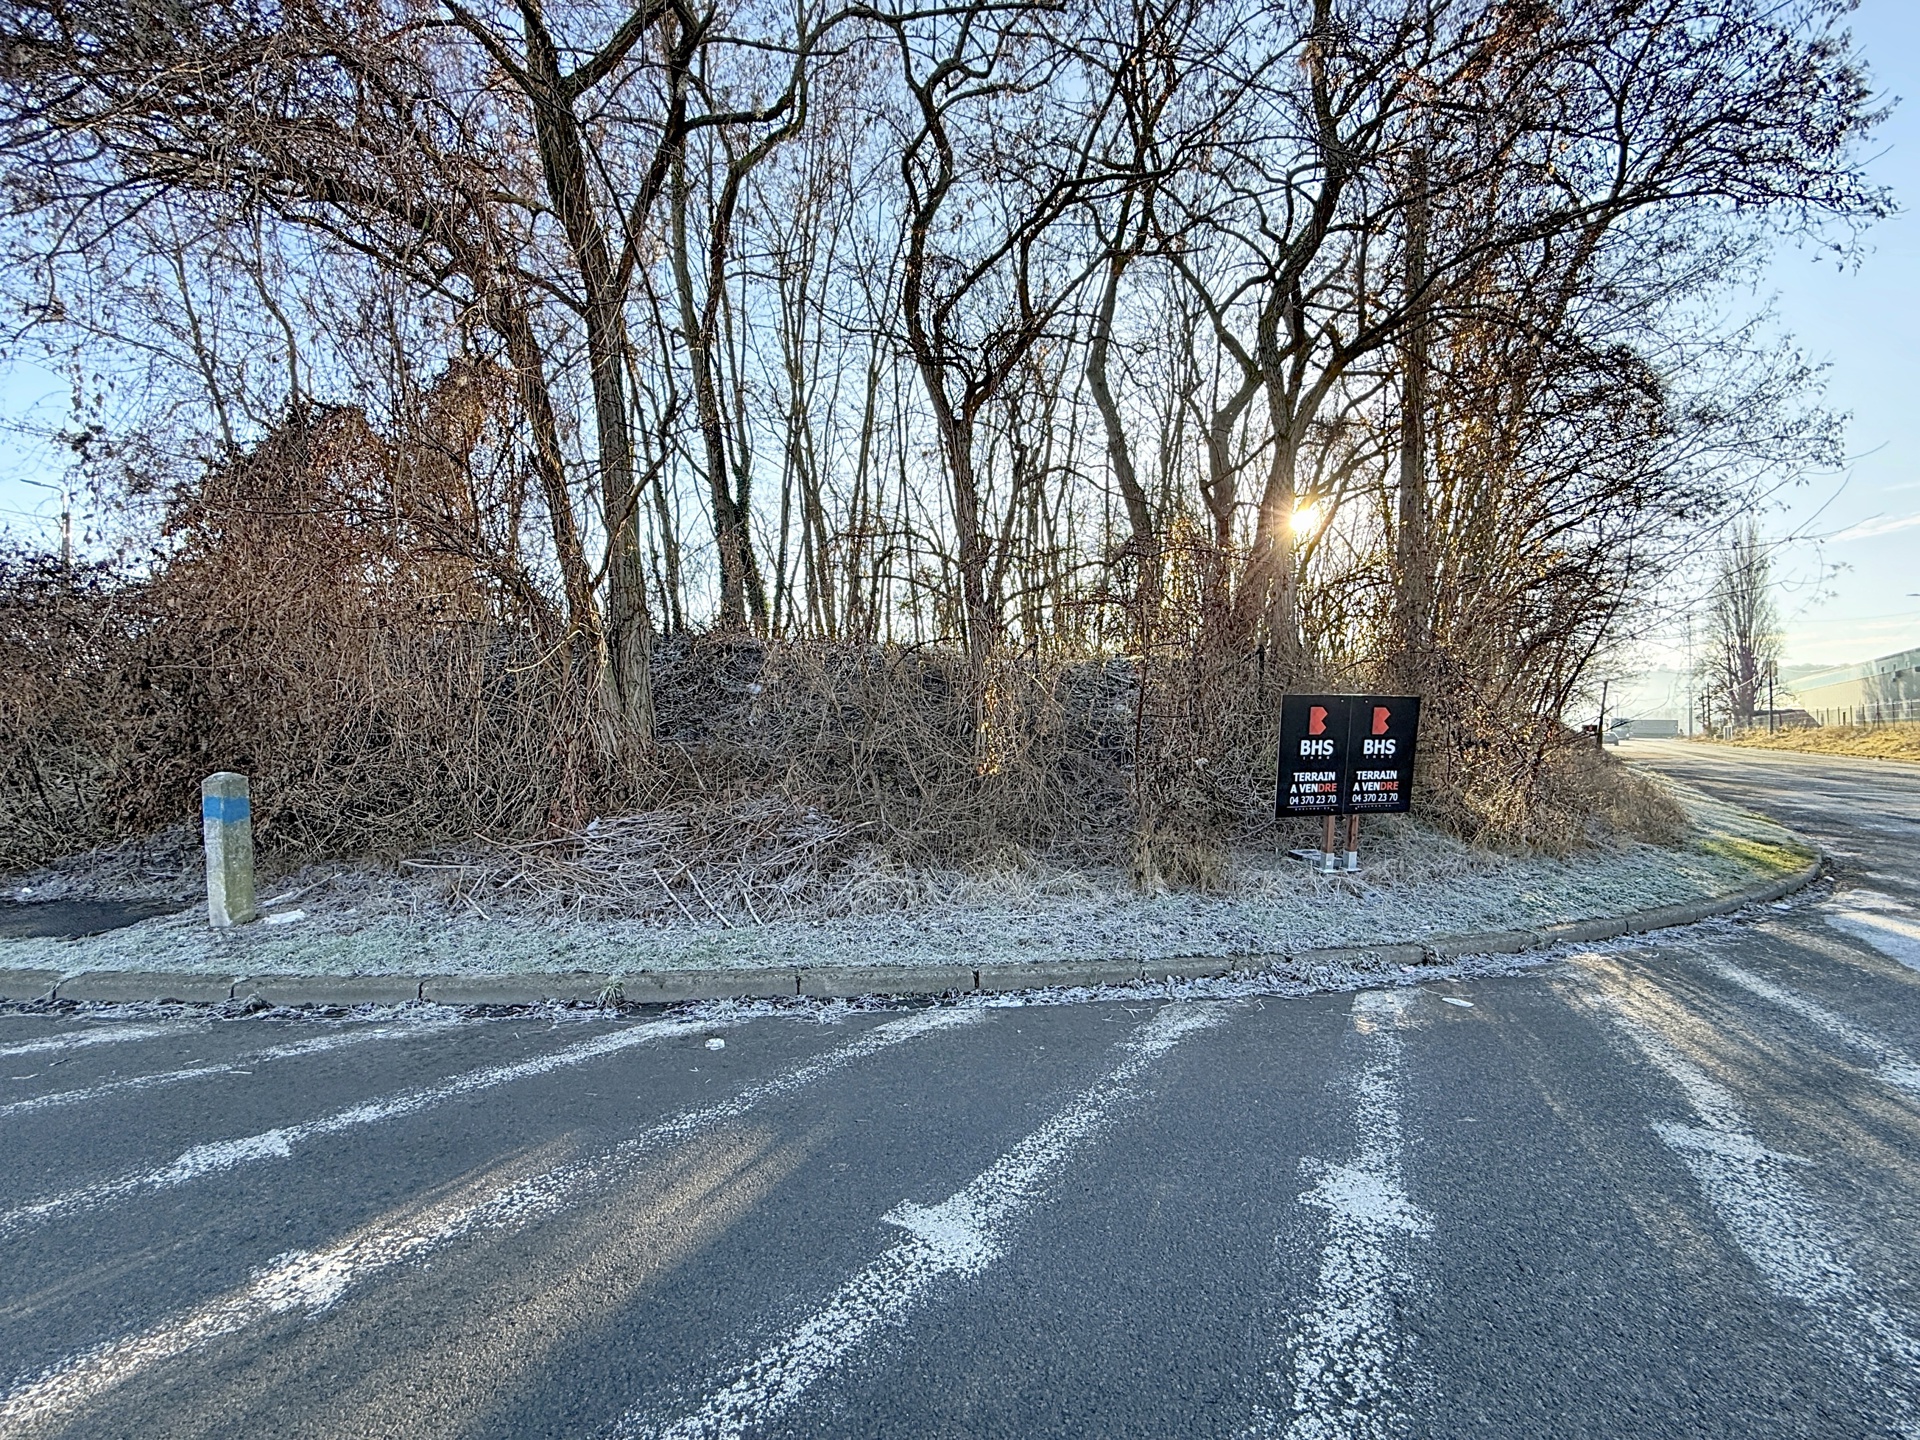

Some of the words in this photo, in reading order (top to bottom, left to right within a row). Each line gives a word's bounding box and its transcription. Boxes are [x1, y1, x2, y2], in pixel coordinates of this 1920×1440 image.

[1300, 740, 1334, 755] BHS
[1364, 739, 1396, 755] BHS
[1293, 772, 1336, 782] TERRAIN
[1356, 770, 1398, 780] TERRAIN
[1290, 784, 1298, 794] A
[1299, 783, 1337, 793] VENDRE
[1353, 782, 1360, 792] A
[1361, 781, 1399, 791] VENDRE
[1289, 796, 1299, 805] 04
[1300, 795, 1315, 805] 370
[1315, 795, 1326, 804] 23
[1327, 794, 1337, 804] 70
[1352, 794, 1361, 803] 04
[1362, 793, 1377, 802] 370
[1377, 793, 1387, 802] 23
[1388, 792, 1398, 801] 70
